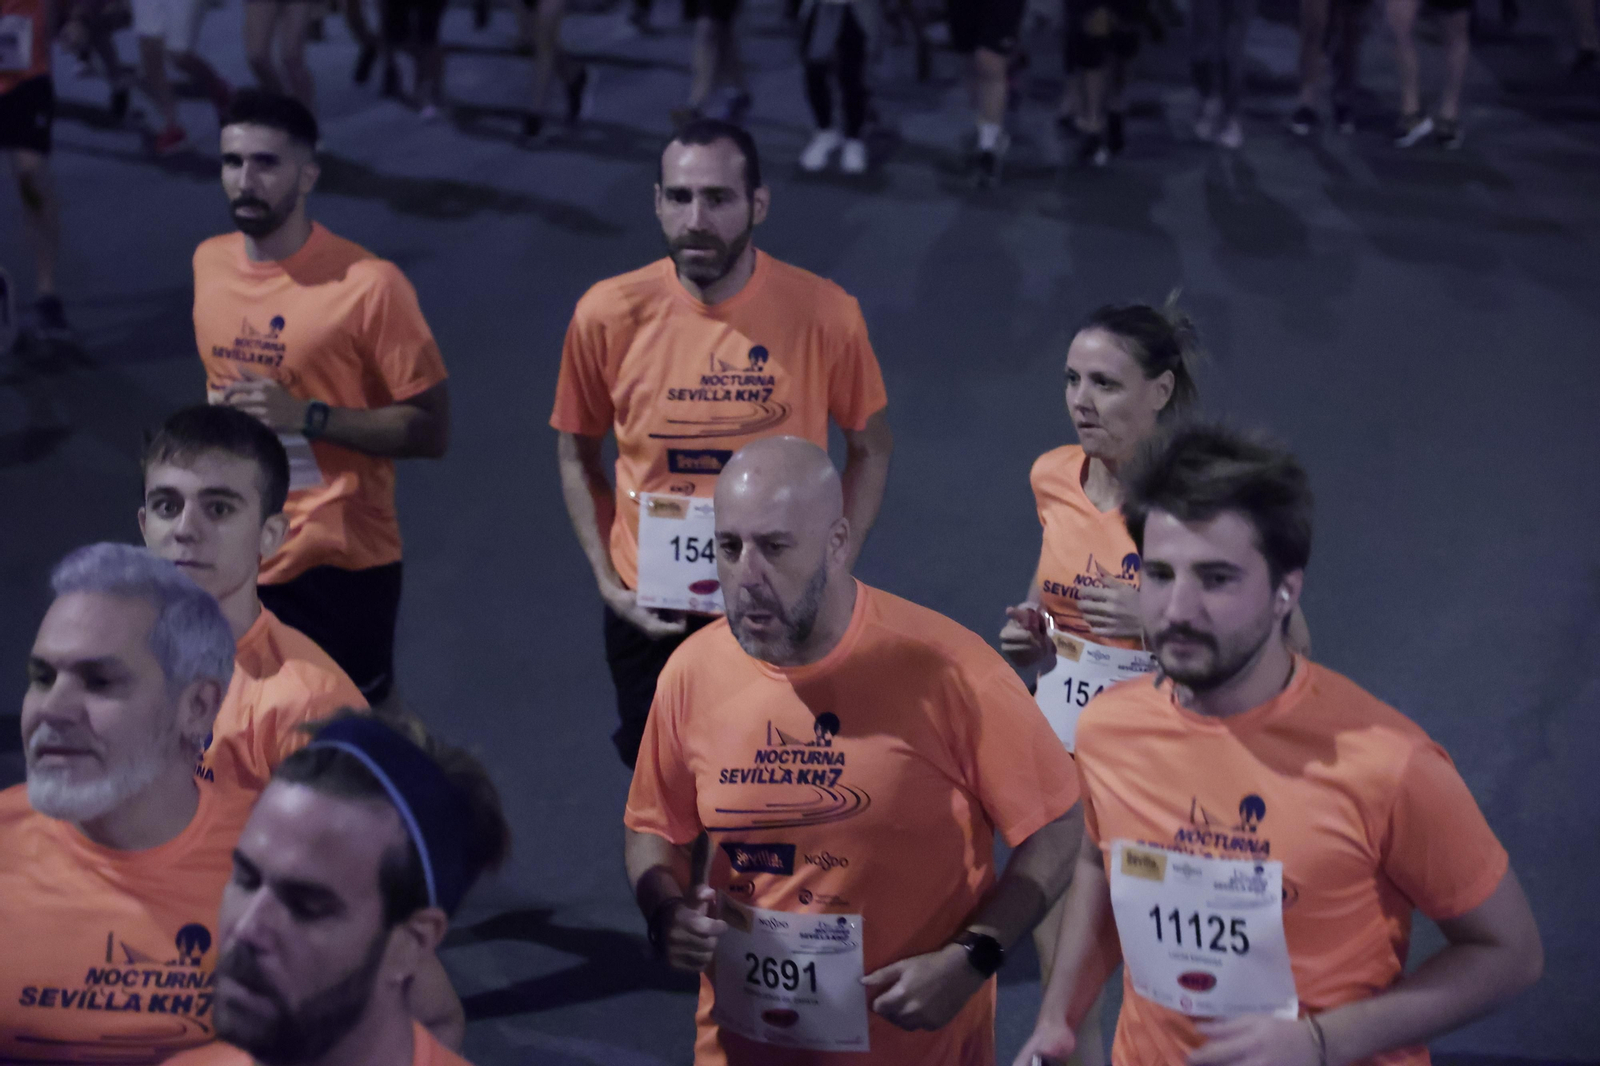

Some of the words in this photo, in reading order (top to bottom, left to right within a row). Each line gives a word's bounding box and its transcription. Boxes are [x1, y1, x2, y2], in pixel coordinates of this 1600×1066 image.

[701, 375, 775, 386] NOCTURNA
[667, 388, 731, 401] SEVILLA
[735, 388, 773, 403] KH7
[1043, 580, 1083, 600] SEVIL
[755, 750, 846, 767] NOCTURNA
[719, 768, 794, 785] SEVILLA
[796, 768, 843, 787] KH7
[1149, 903, 1250, 956] 11125
[745, 952, 817, 994] 2691
[19, 986, 141, 1013] SEVILLA
[148, 993, 214, 1017] KH7
